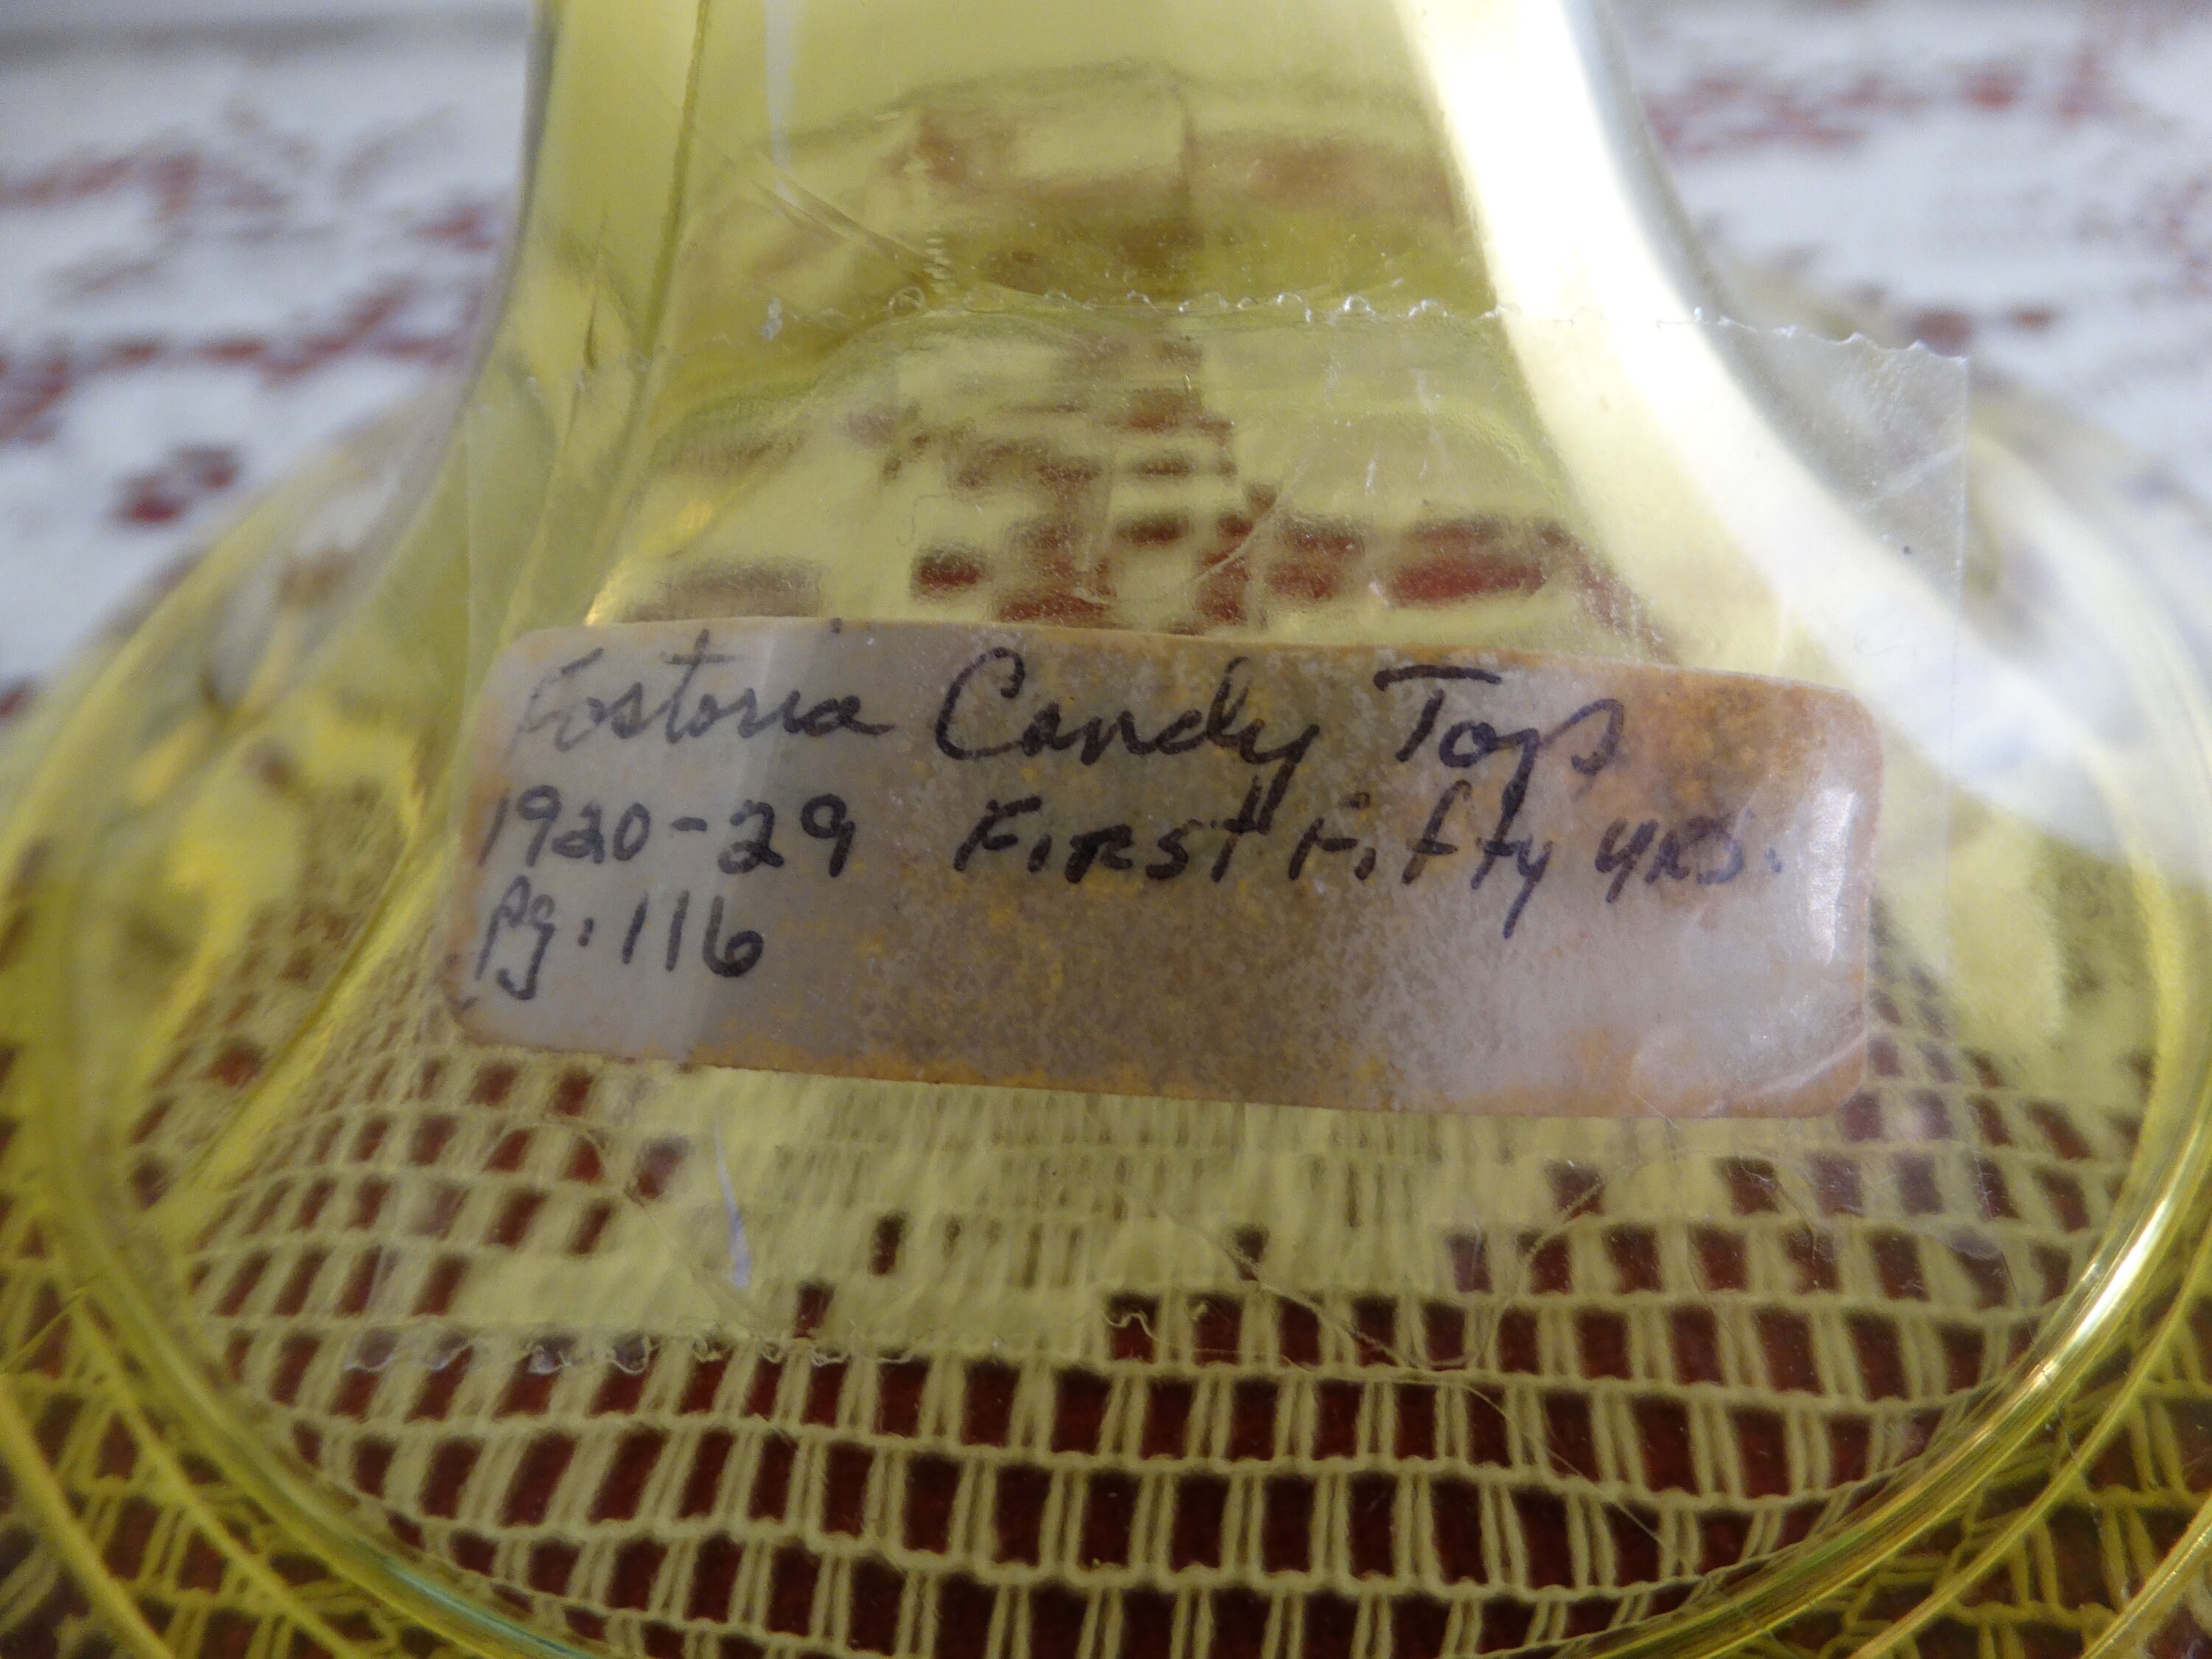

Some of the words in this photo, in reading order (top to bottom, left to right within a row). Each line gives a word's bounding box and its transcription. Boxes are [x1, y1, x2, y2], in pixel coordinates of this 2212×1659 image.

[507, 628, 895, 757] Fostoria
[934, 646, 1321, 835] Candy
[477, 784, 858, 877] 1920-29
[621, 889, 765, 978] 116
